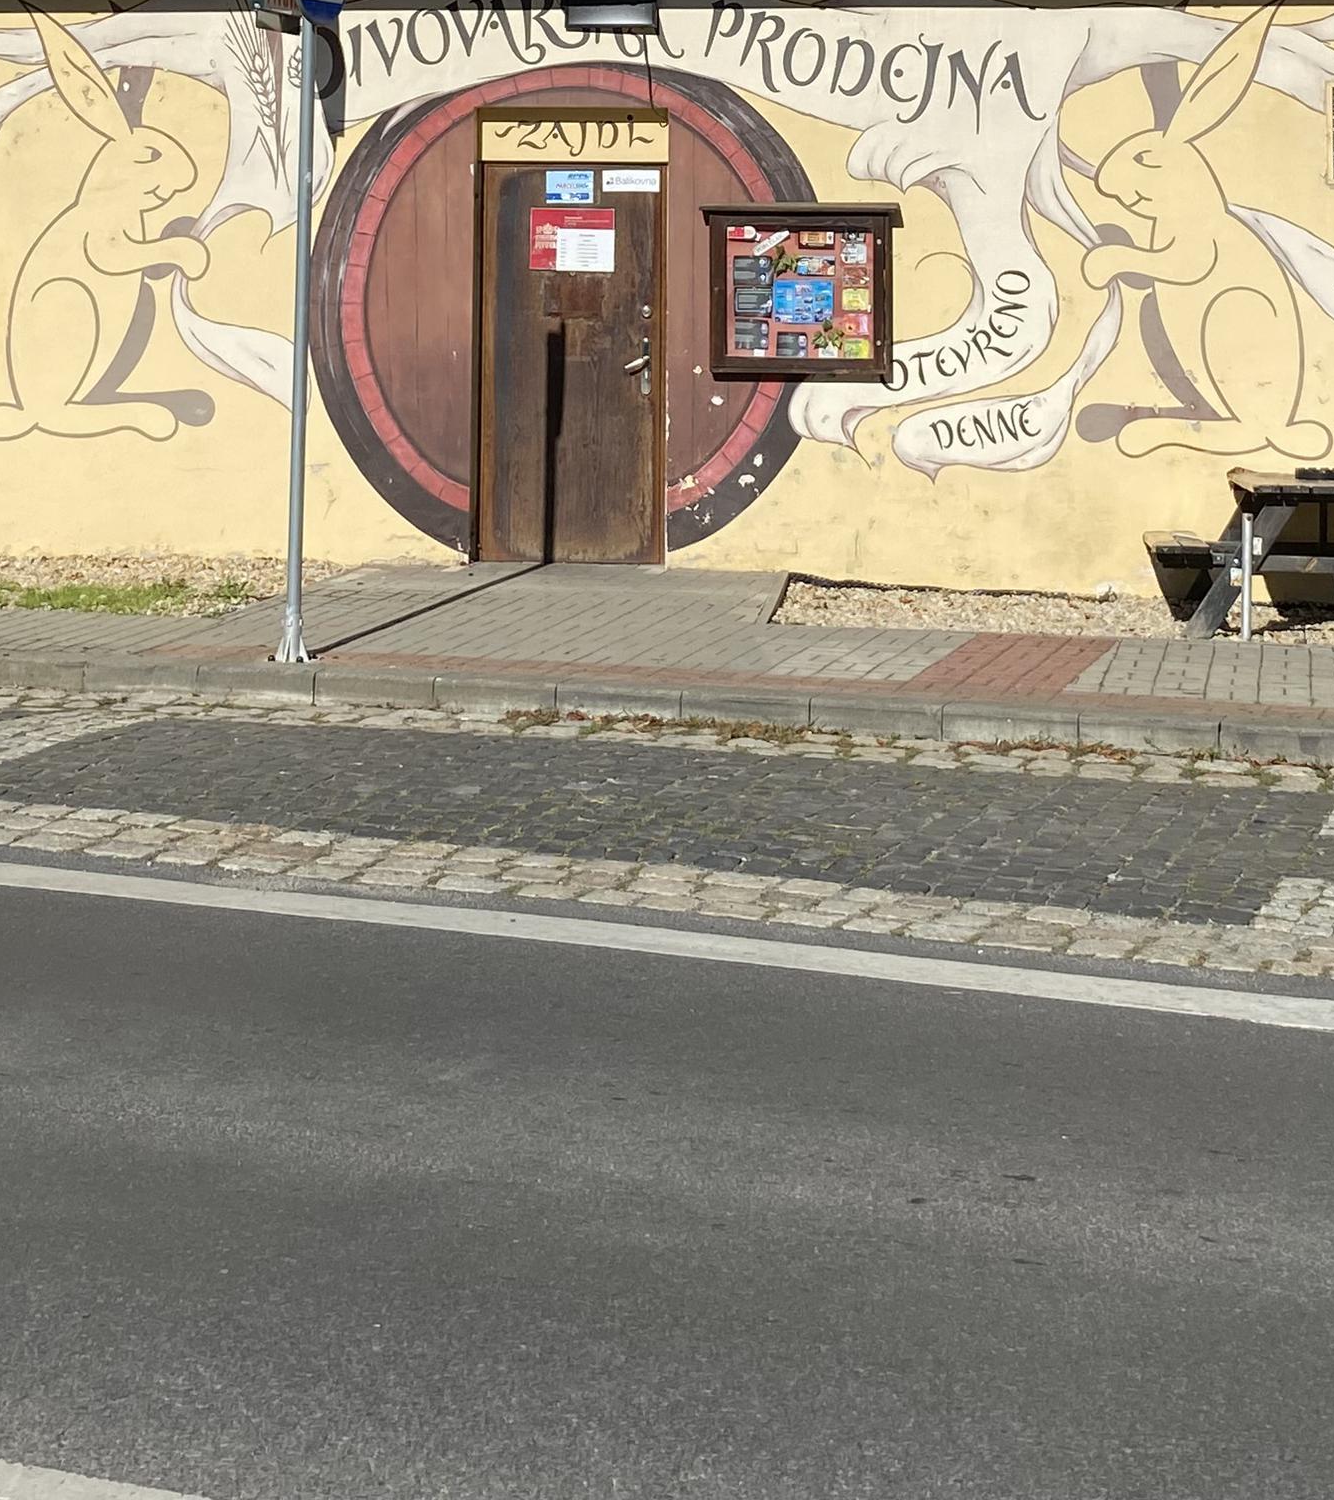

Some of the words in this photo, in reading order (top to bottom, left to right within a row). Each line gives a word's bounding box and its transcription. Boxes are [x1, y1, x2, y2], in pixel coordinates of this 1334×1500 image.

[703, 0, 1048, 135] PRODEJNA
[881, 269, 1031, 392] OTEVŘENO
[928, 399, 1042, 451] DENNĚ
